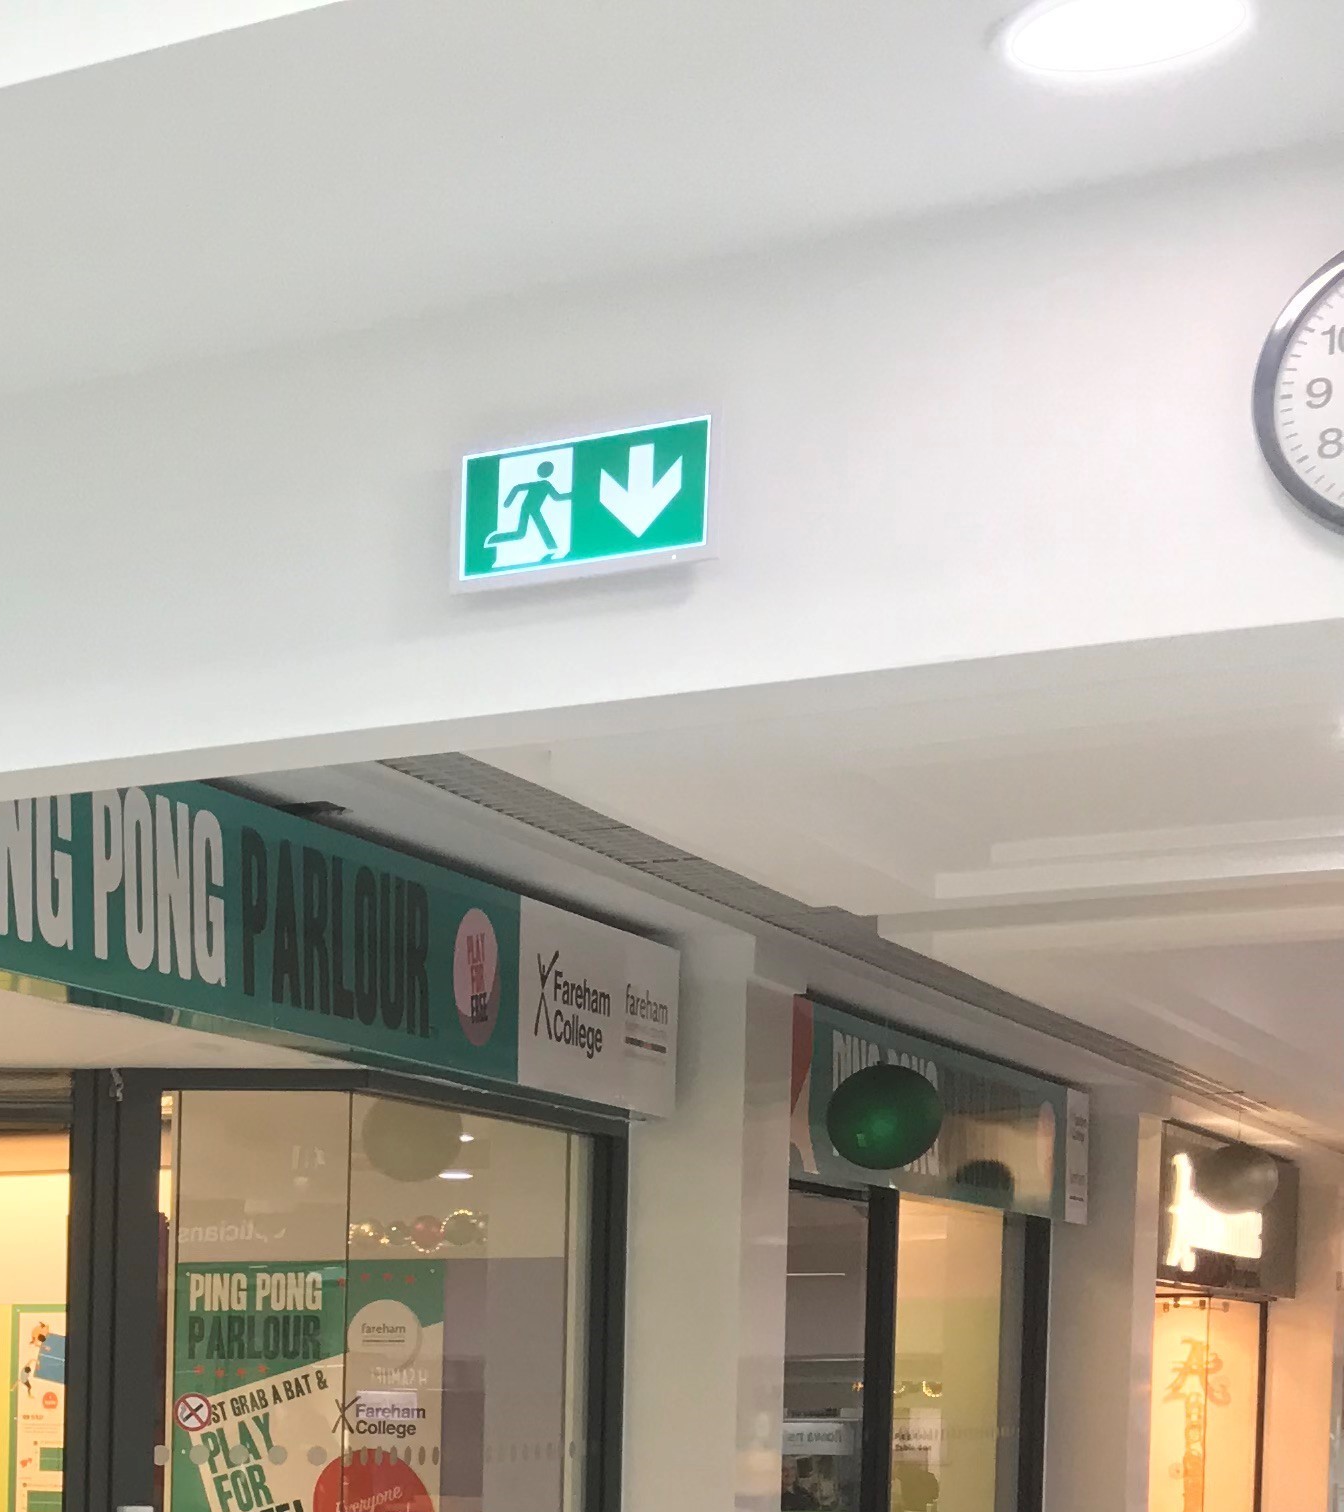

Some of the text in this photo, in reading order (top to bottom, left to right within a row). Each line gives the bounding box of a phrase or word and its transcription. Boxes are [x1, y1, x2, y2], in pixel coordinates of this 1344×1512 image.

[1305, 377, 1333, 409] 9
[1317, 427, 1344, 459] 8
[92, 787, 226, 988] PONG
[241, 826, 431, 1039] PARLOUR
[553, 970, 611, 1018] Fareham
[625, 983, 669, 1025] fareham
[553, 1009, 603, 1059] College
[189, 1272, 322, 1311] PING PONG
[188, 1315, 321, 1359] PARLOUR
[361, 1323, 406, 1334] fareham
[231, 1393, 268, 1418] GRAB
[271, 1385, 283, 1405] A
[284, 1373, 312, 1401] BAT
[315, 1370, 328, 1390] &
[356, 1403, 426, 1419] Fareham
[200, 1412, 274, 1474] PLAY
[356, 1420, 416, 1438] College
